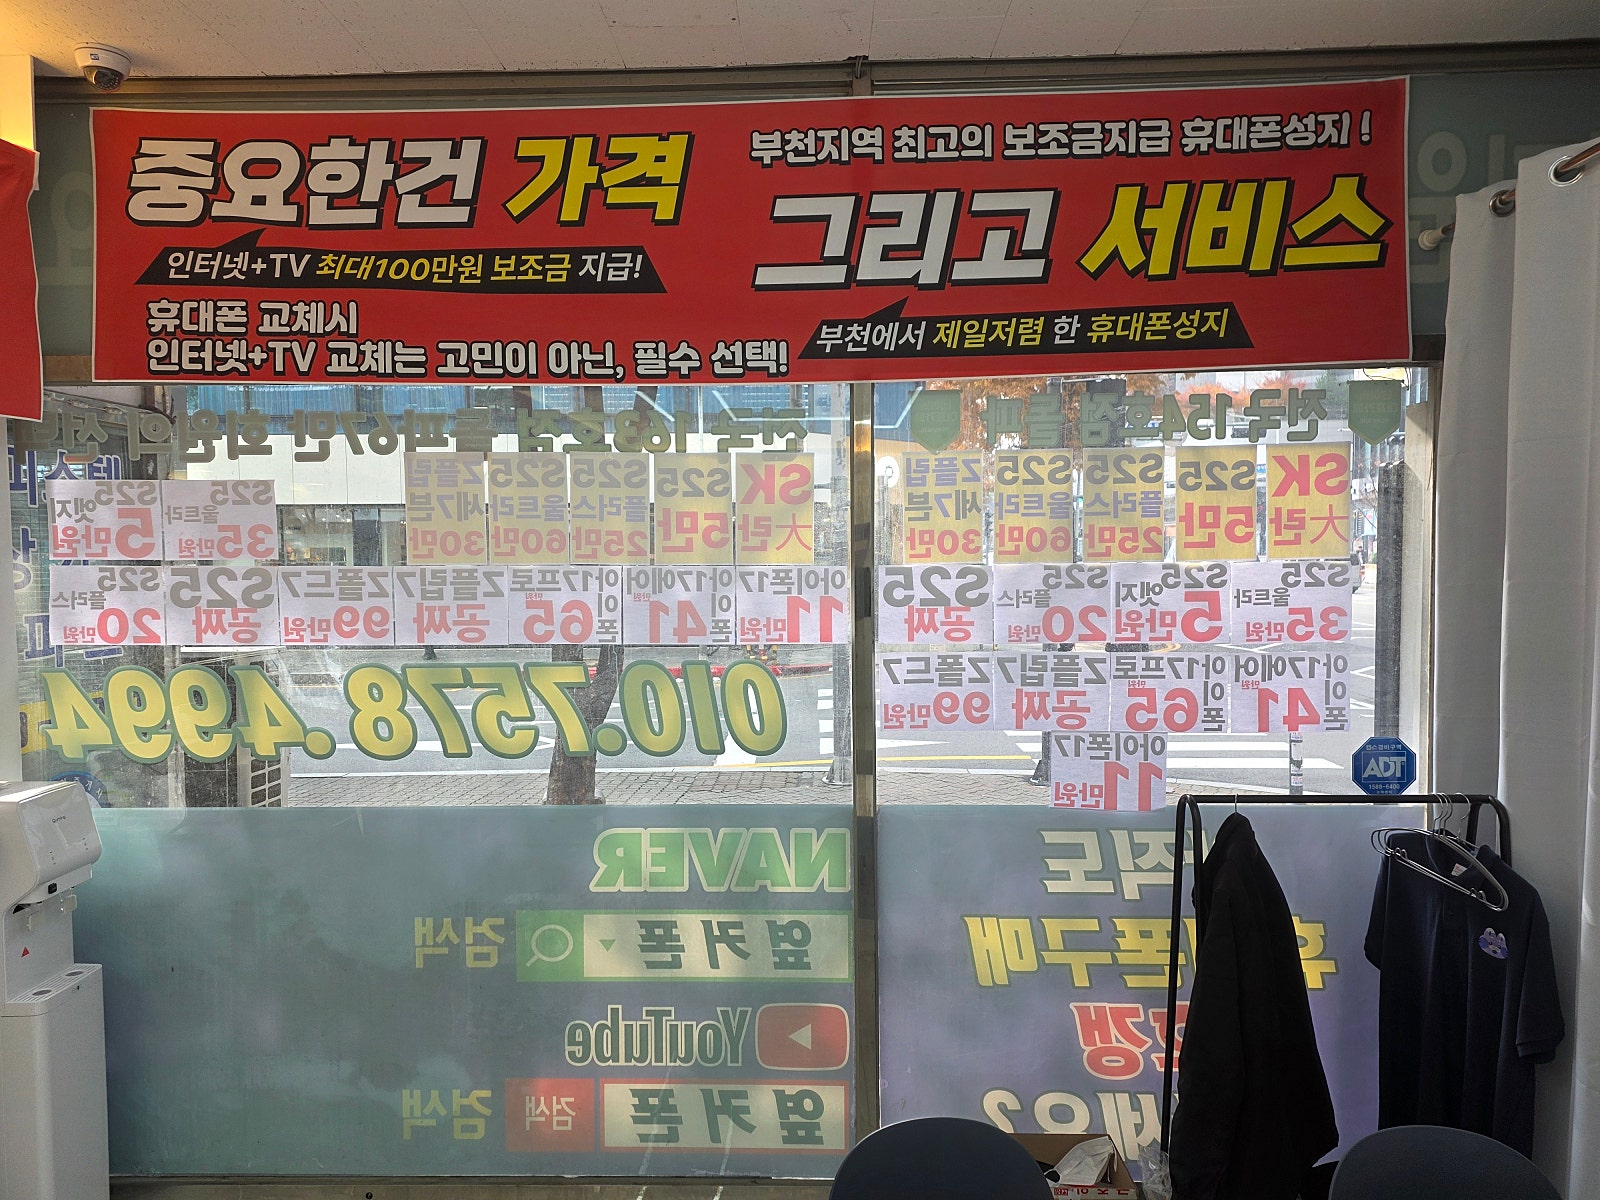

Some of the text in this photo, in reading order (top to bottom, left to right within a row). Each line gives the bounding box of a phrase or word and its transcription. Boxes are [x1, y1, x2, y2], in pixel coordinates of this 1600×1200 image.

[751, 126, 883, 168] 부천지역
[893, 123, 993, 162] 최고의
[1003, 119, 1171, 161] 보조금지급
[1181, 112, 1352, 154] 휴대폰성지
[126, 136, 486, 229] 중요한건
[503, 132, 694, 226] 가격
[752, 188, 1061, 292] 그리고
[1075, 173, 1394, 281] 서비스
[168, 251, 643, 284] 인터넷+TV 최대100만원 보조금 지급!
[147, 300, 358, 338] 휴대폰 교체시
[816, 308, 1229, 352] 부천에서 제일저렴 한 휴대폰성지
[147, 339, 789, 383] 인터넷+TV 교체는 고민이 아닌, 필수 선택!
[1362, 756, 1406, 778] ADT
